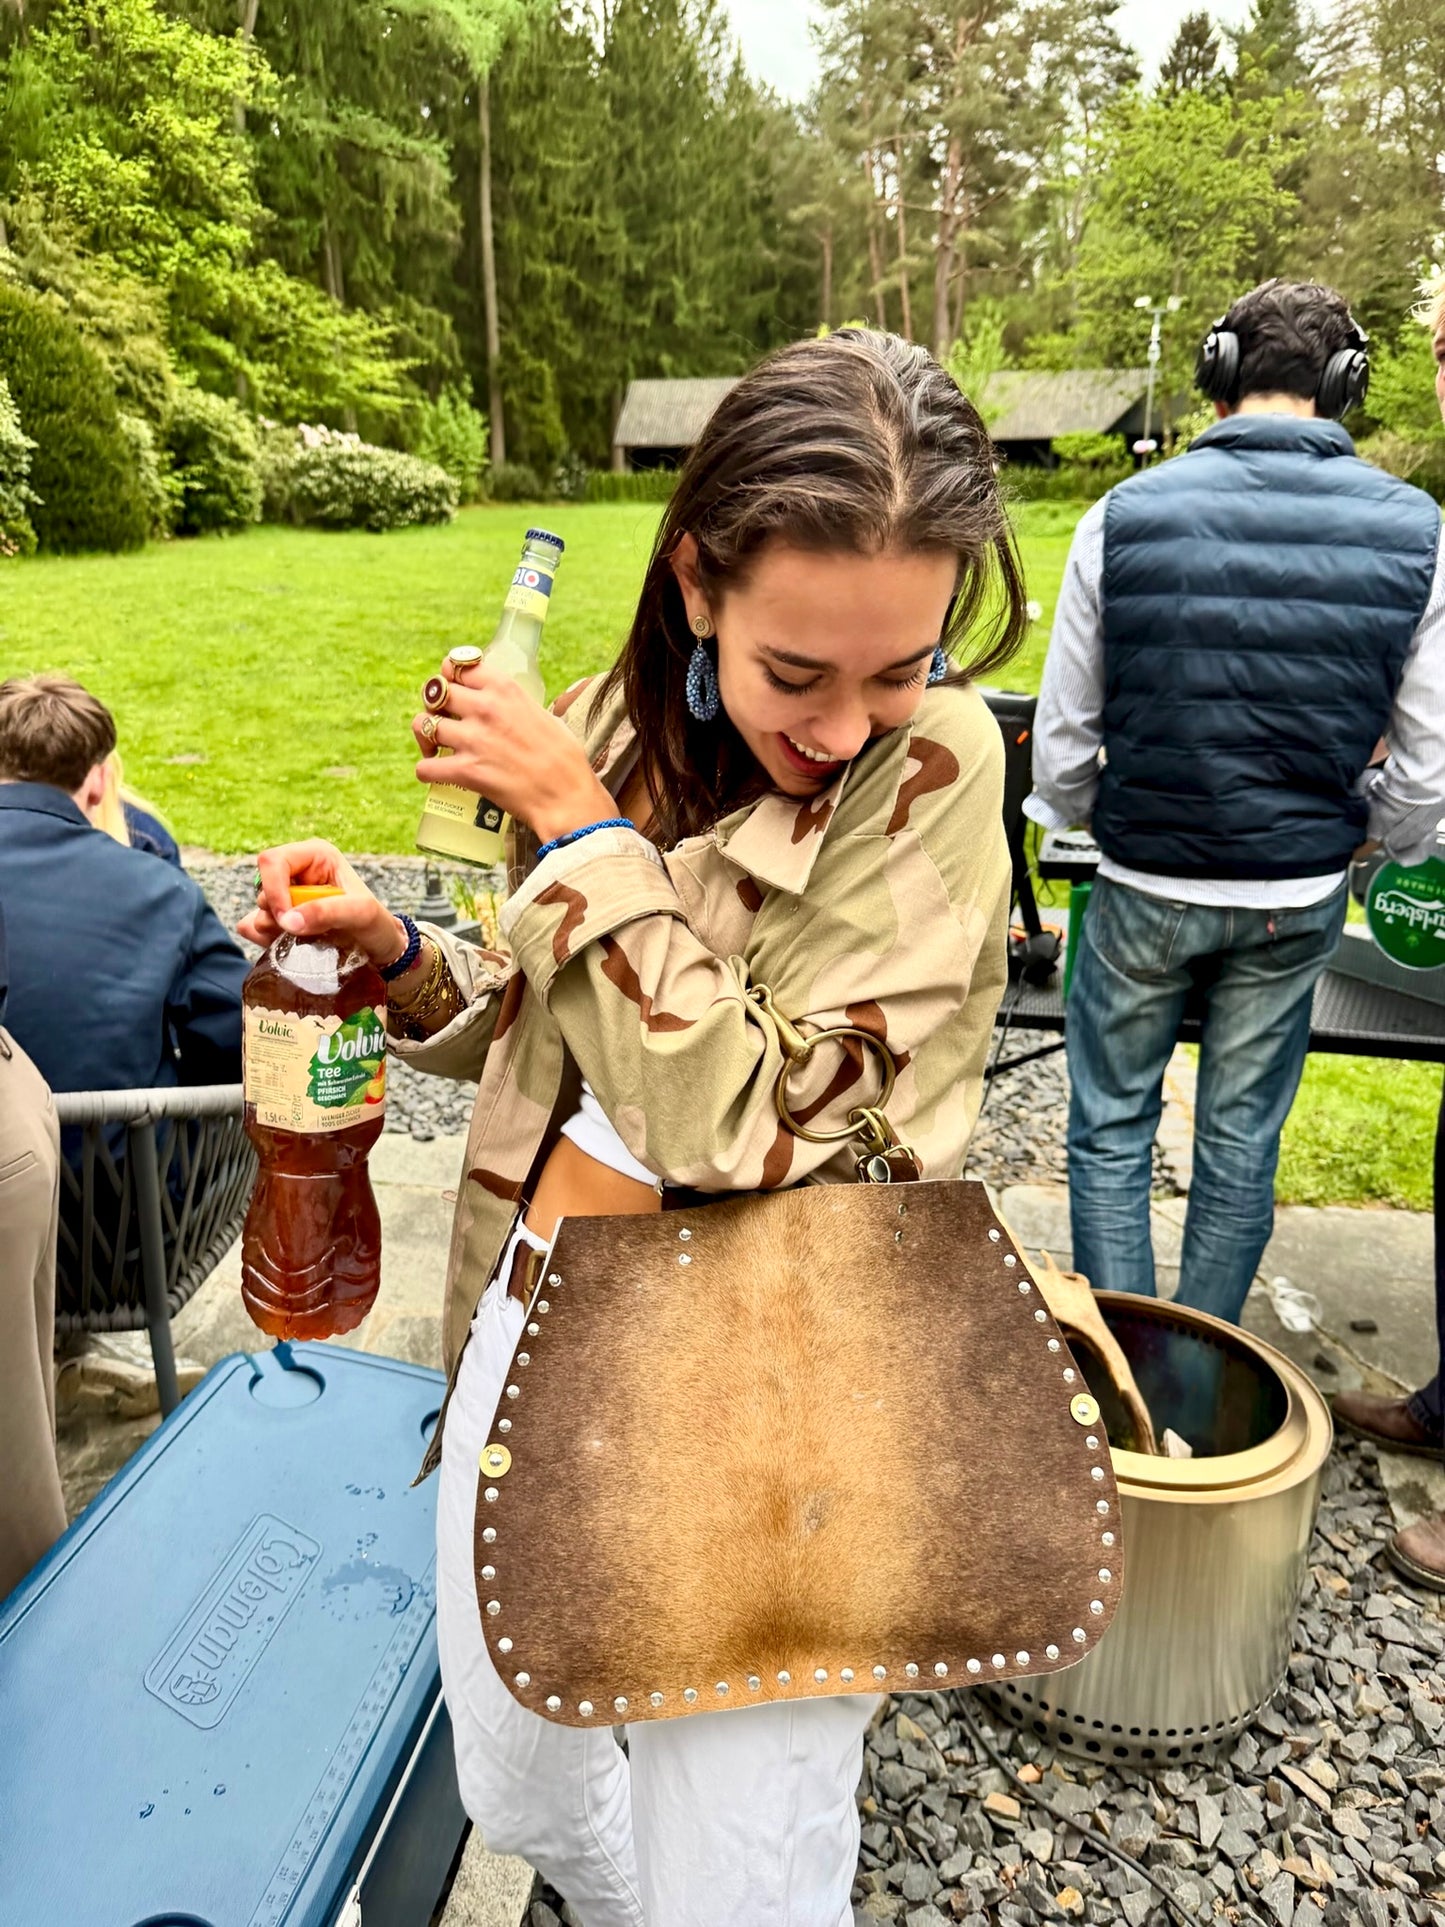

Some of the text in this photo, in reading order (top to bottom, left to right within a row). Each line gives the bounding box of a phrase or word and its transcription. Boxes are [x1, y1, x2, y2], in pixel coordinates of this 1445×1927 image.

[512, 568, 540, 588] BIO
[1375, 890, 1445, 939] arlsberg
[259, 1019, 293, 1038] Volvic
[317, 1027, 386, 1063] Volvic
[317, 1085, 346, 1095] PFIRSICH
[190, 1540, 307, 1670] Coleman
